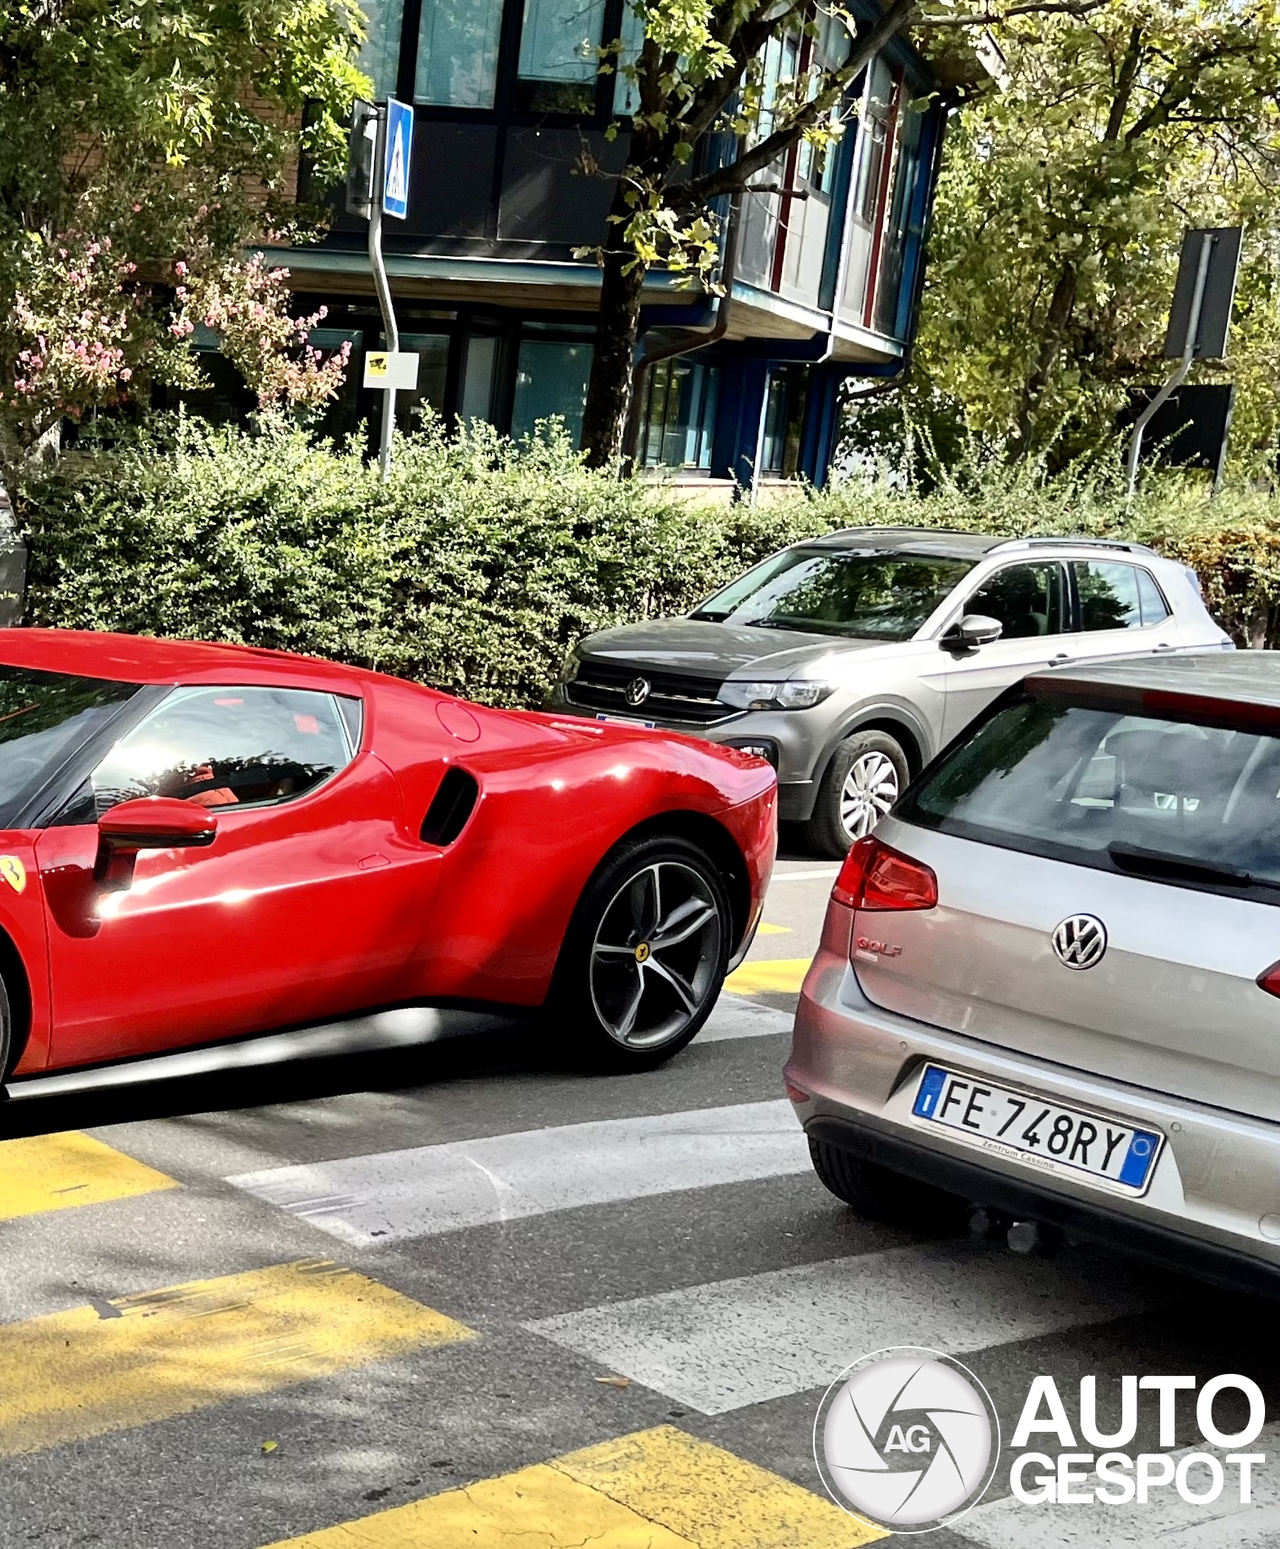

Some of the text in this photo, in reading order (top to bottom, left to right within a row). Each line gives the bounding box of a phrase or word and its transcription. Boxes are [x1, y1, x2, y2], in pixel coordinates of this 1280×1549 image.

[857, 936, 902, 957] GOLF
[982, 1140, 1055, 1169] Zentrum Cassino
